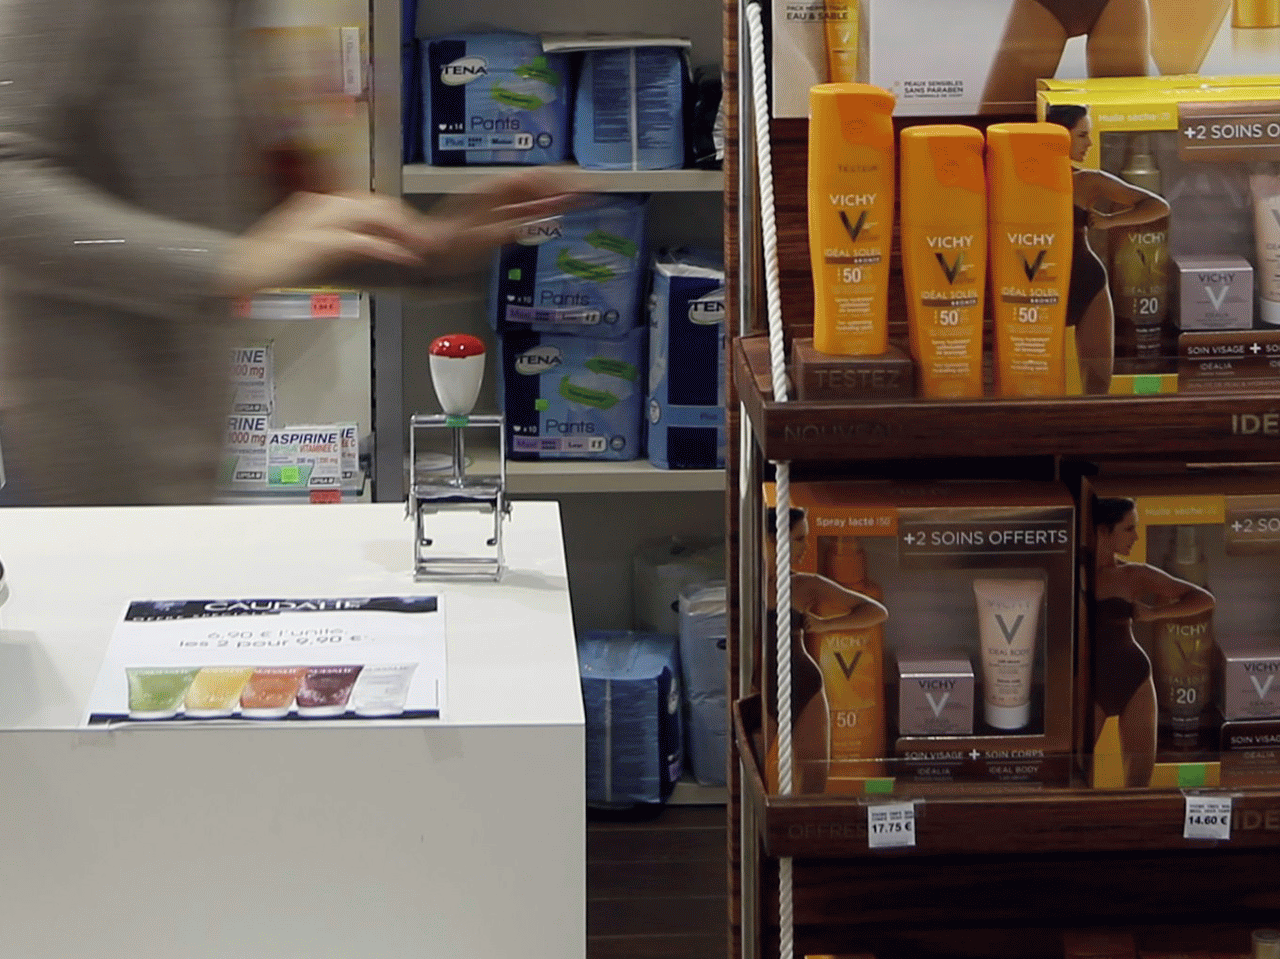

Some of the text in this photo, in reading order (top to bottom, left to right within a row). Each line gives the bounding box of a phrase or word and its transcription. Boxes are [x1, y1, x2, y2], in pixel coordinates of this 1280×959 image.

[442, 65, 487, 76] TENA
[471, 116, 520, 130] Pants
[1210, 123, 1262, 137] SOINS
[830, 194, 876, 207] VICHY
[843, 267, 861, 283] 50
[270, 433, 337, 445] ASPIRINE
[1188, 815, 1219, 826] 14.60
[871, 822, 902, 834] 17.75
